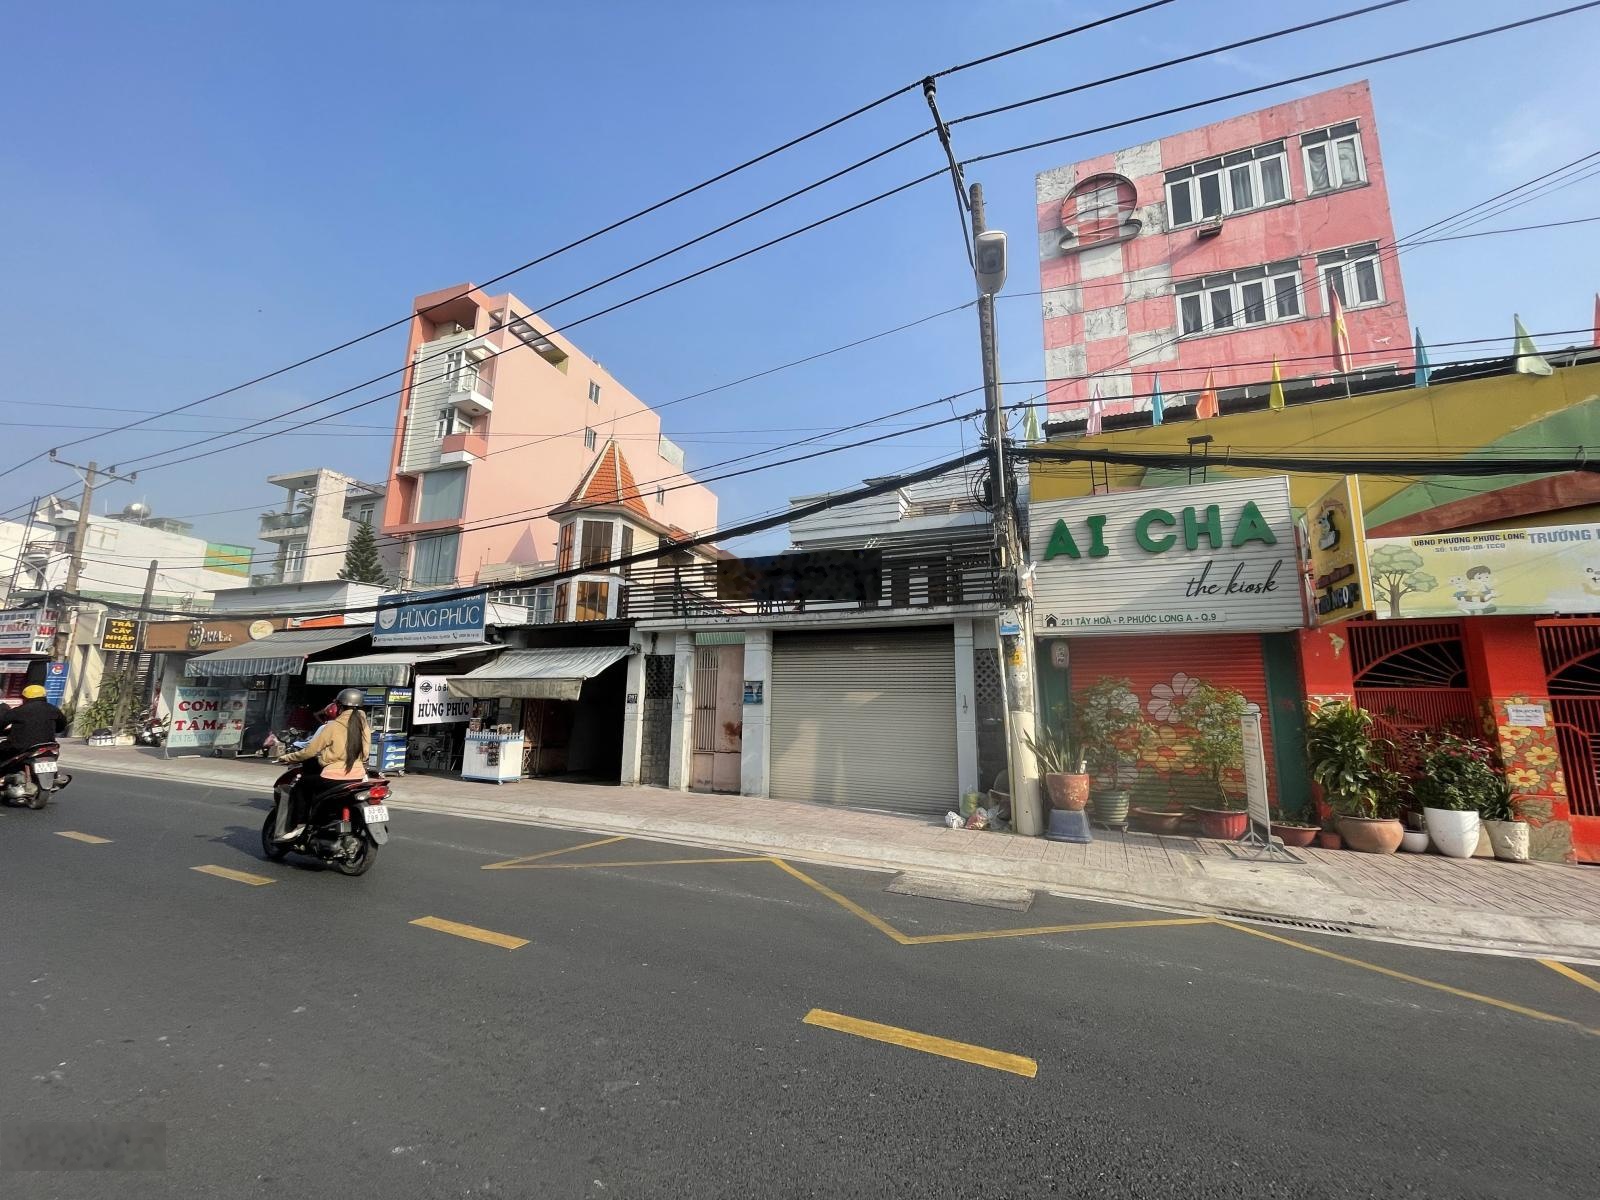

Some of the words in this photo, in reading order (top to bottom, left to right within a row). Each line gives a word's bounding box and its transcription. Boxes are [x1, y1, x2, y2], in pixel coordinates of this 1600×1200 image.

[1044, 514, 1110, 561] AI
[1135, 500, 1278, 553] CHA
[1185, 560, 1222, 597] the
[1224, 560, 1283, 595] kiosk
[399, 607, 437, 629] HÙNG
[439, 603, 480, 626] PHÚC
[1061, 618, 1073, 626] 211
[1075, 617, 1091, 625] TÂY
[1093, 615, 1112, 625] HOÀ
[1159, 614, 1184, 623] LONG
[1186, 613, 1193, 622] A
[1200, 613, 1217, 622] Q.9
[178, 699, 219, 712] CƠM
[174, 714, 218, 731] TẤM
